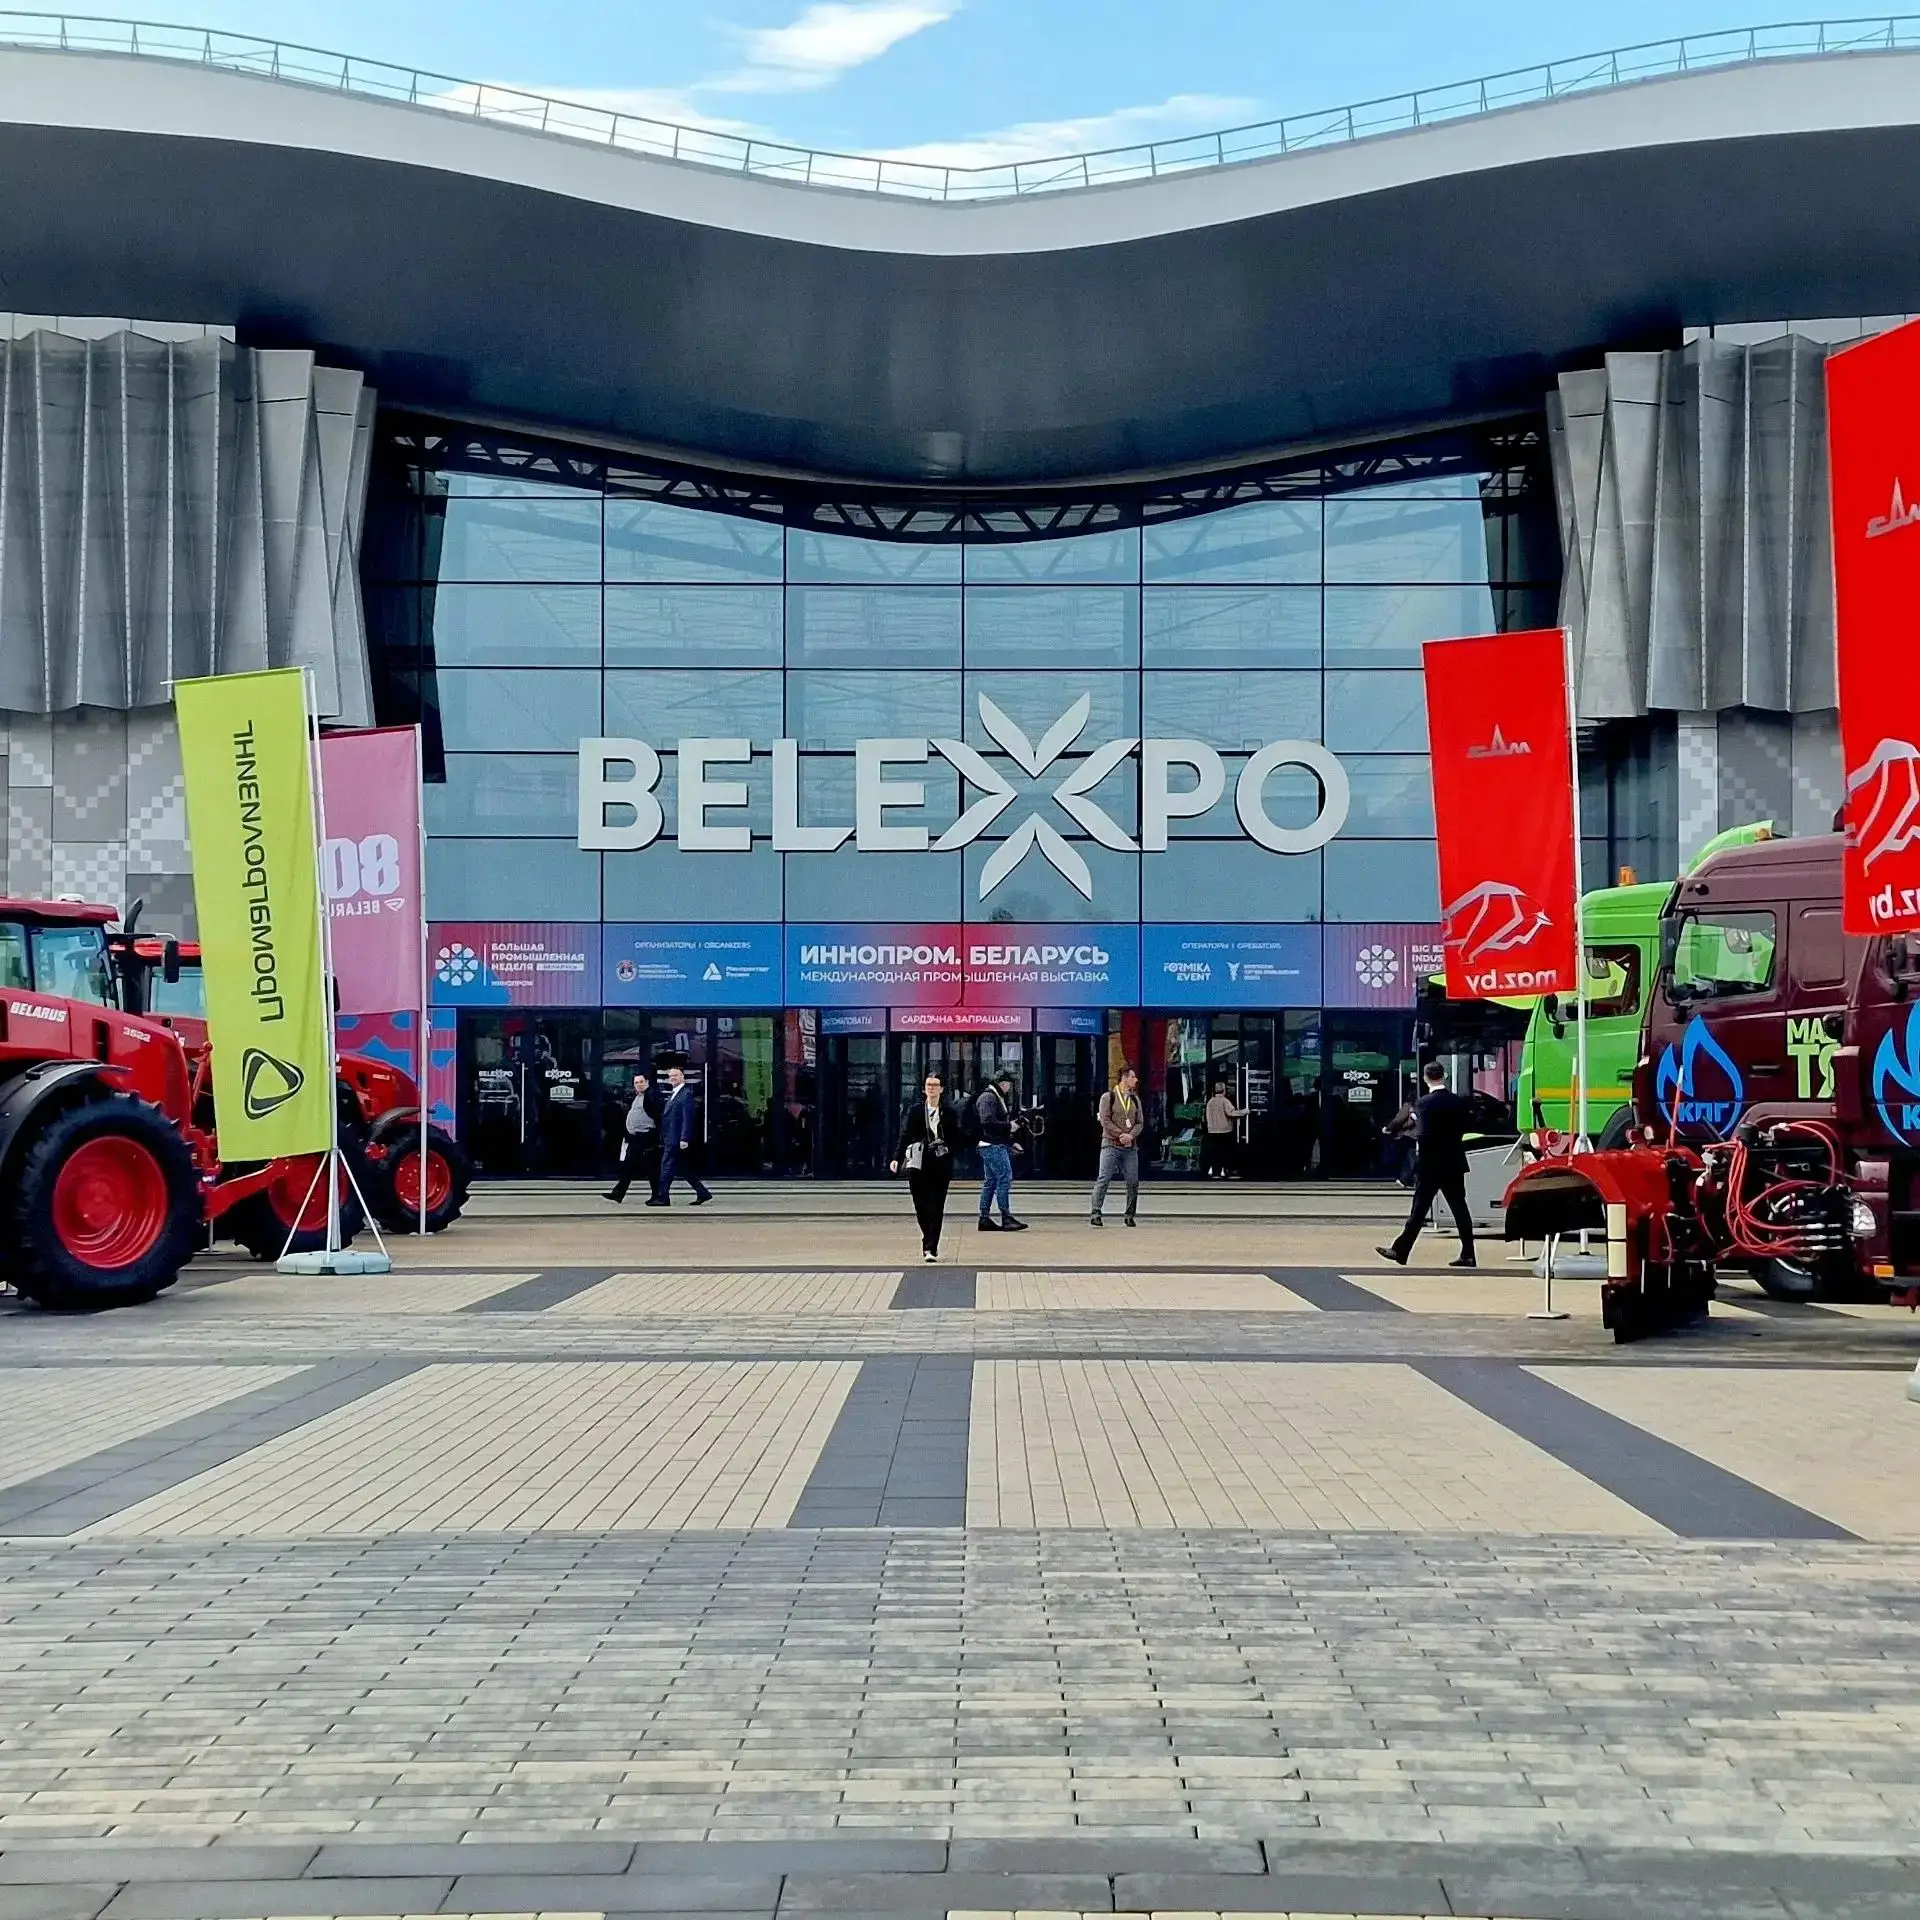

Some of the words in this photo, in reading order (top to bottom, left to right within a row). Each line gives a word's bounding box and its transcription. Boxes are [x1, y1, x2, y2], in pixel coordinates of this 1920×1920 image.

[577, 691, 1350, 903] BELEXPO
[491, 943, 544, 951] БОЛЬШАЯ
[1411, 945, 1430, 953] BIG
[491, 953, 585, 961] ПРОМЫШЛЕННАЯ
[800, 945, 961, 965] ИННОПРОМ.
[970, 945, 1109, 965] БЕЛАРУСЬ
[1411, 954, 1444, 963] INDUS
[491, 963, 533, 971] НЕДЕЛЯ
[1163, 962, 1212, 973] FORMIKA
[800, 971, 920, 984] МЕЖДУНАРОДНАЯ
[923, 971, 1038, 983] ПРОМЫШЛЕННАЯ
[1041, 971, 1109, 983] ВЫСТАВКА
[1176, 973, 1212, 981] EVENT
[9, 1001, 68, 1023] BELARUS
[901, 1015, 953, 1025] САРДЭЧНА
[956, 1015, 1021, 1025] ЗАПРАШАЕМ!
[1787, 1018, 1838, 1044] МА
[1787, 1043, 1841, 1099] ТЯ
[1678, 1102, 1730, 1122] КПГ
